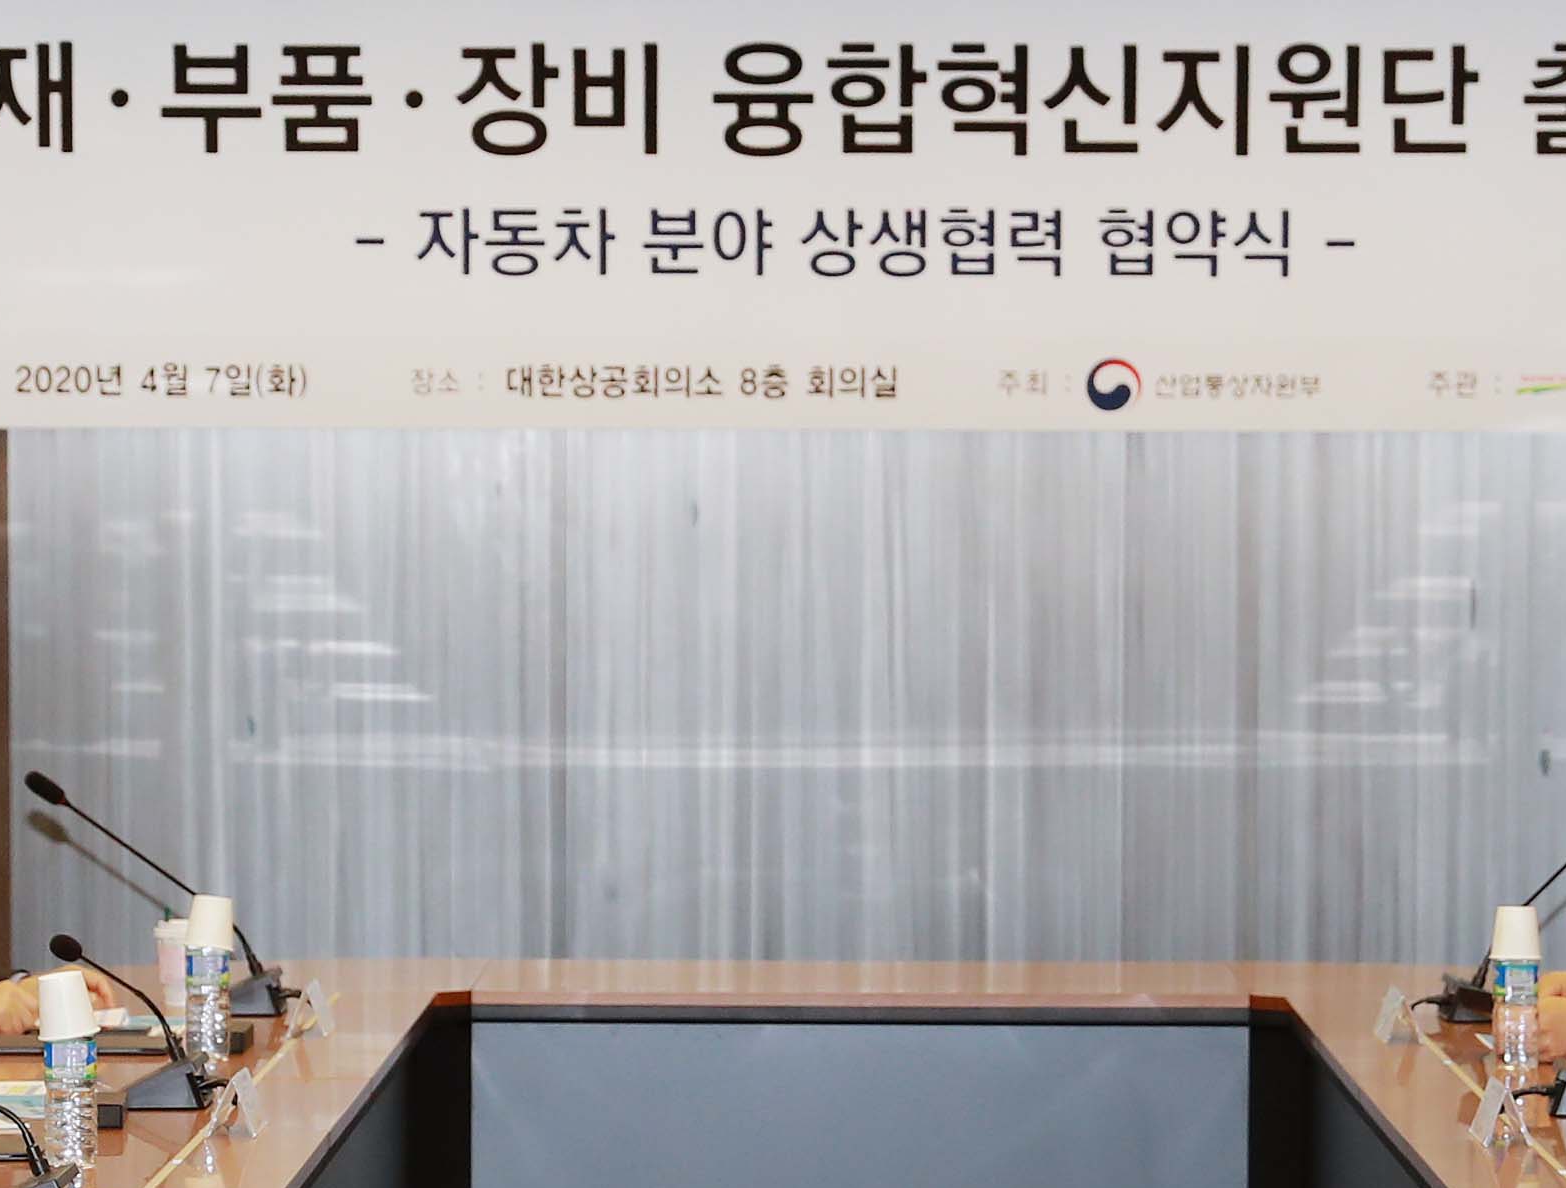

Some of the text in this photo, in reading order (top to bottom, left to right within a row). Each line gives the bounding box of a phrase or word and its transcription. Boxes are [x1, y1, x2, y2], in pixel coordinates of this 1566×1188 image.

[712, 41, 1480, 157] 융합혁신지원단
[417, 207, 616, 277] 자동차
[642, 208, 774, 277] 분야
[800, 208, 1063, 278] 상생협력
[1098, 208, 1291, 278] 협약식
[14, 363, 124, 397] 2020년
[139, 361, 190, 397] 4월
[204, 363, 308, 399] 7일(화)
[411, 367, 460, 395] 장소
[505, 364, 724, 398] 대한상공회의소
[738, 364, 790, 399] 8층
[806, 364, 899, 399] 회의실
[996, 368, 1048, 396] 주최
